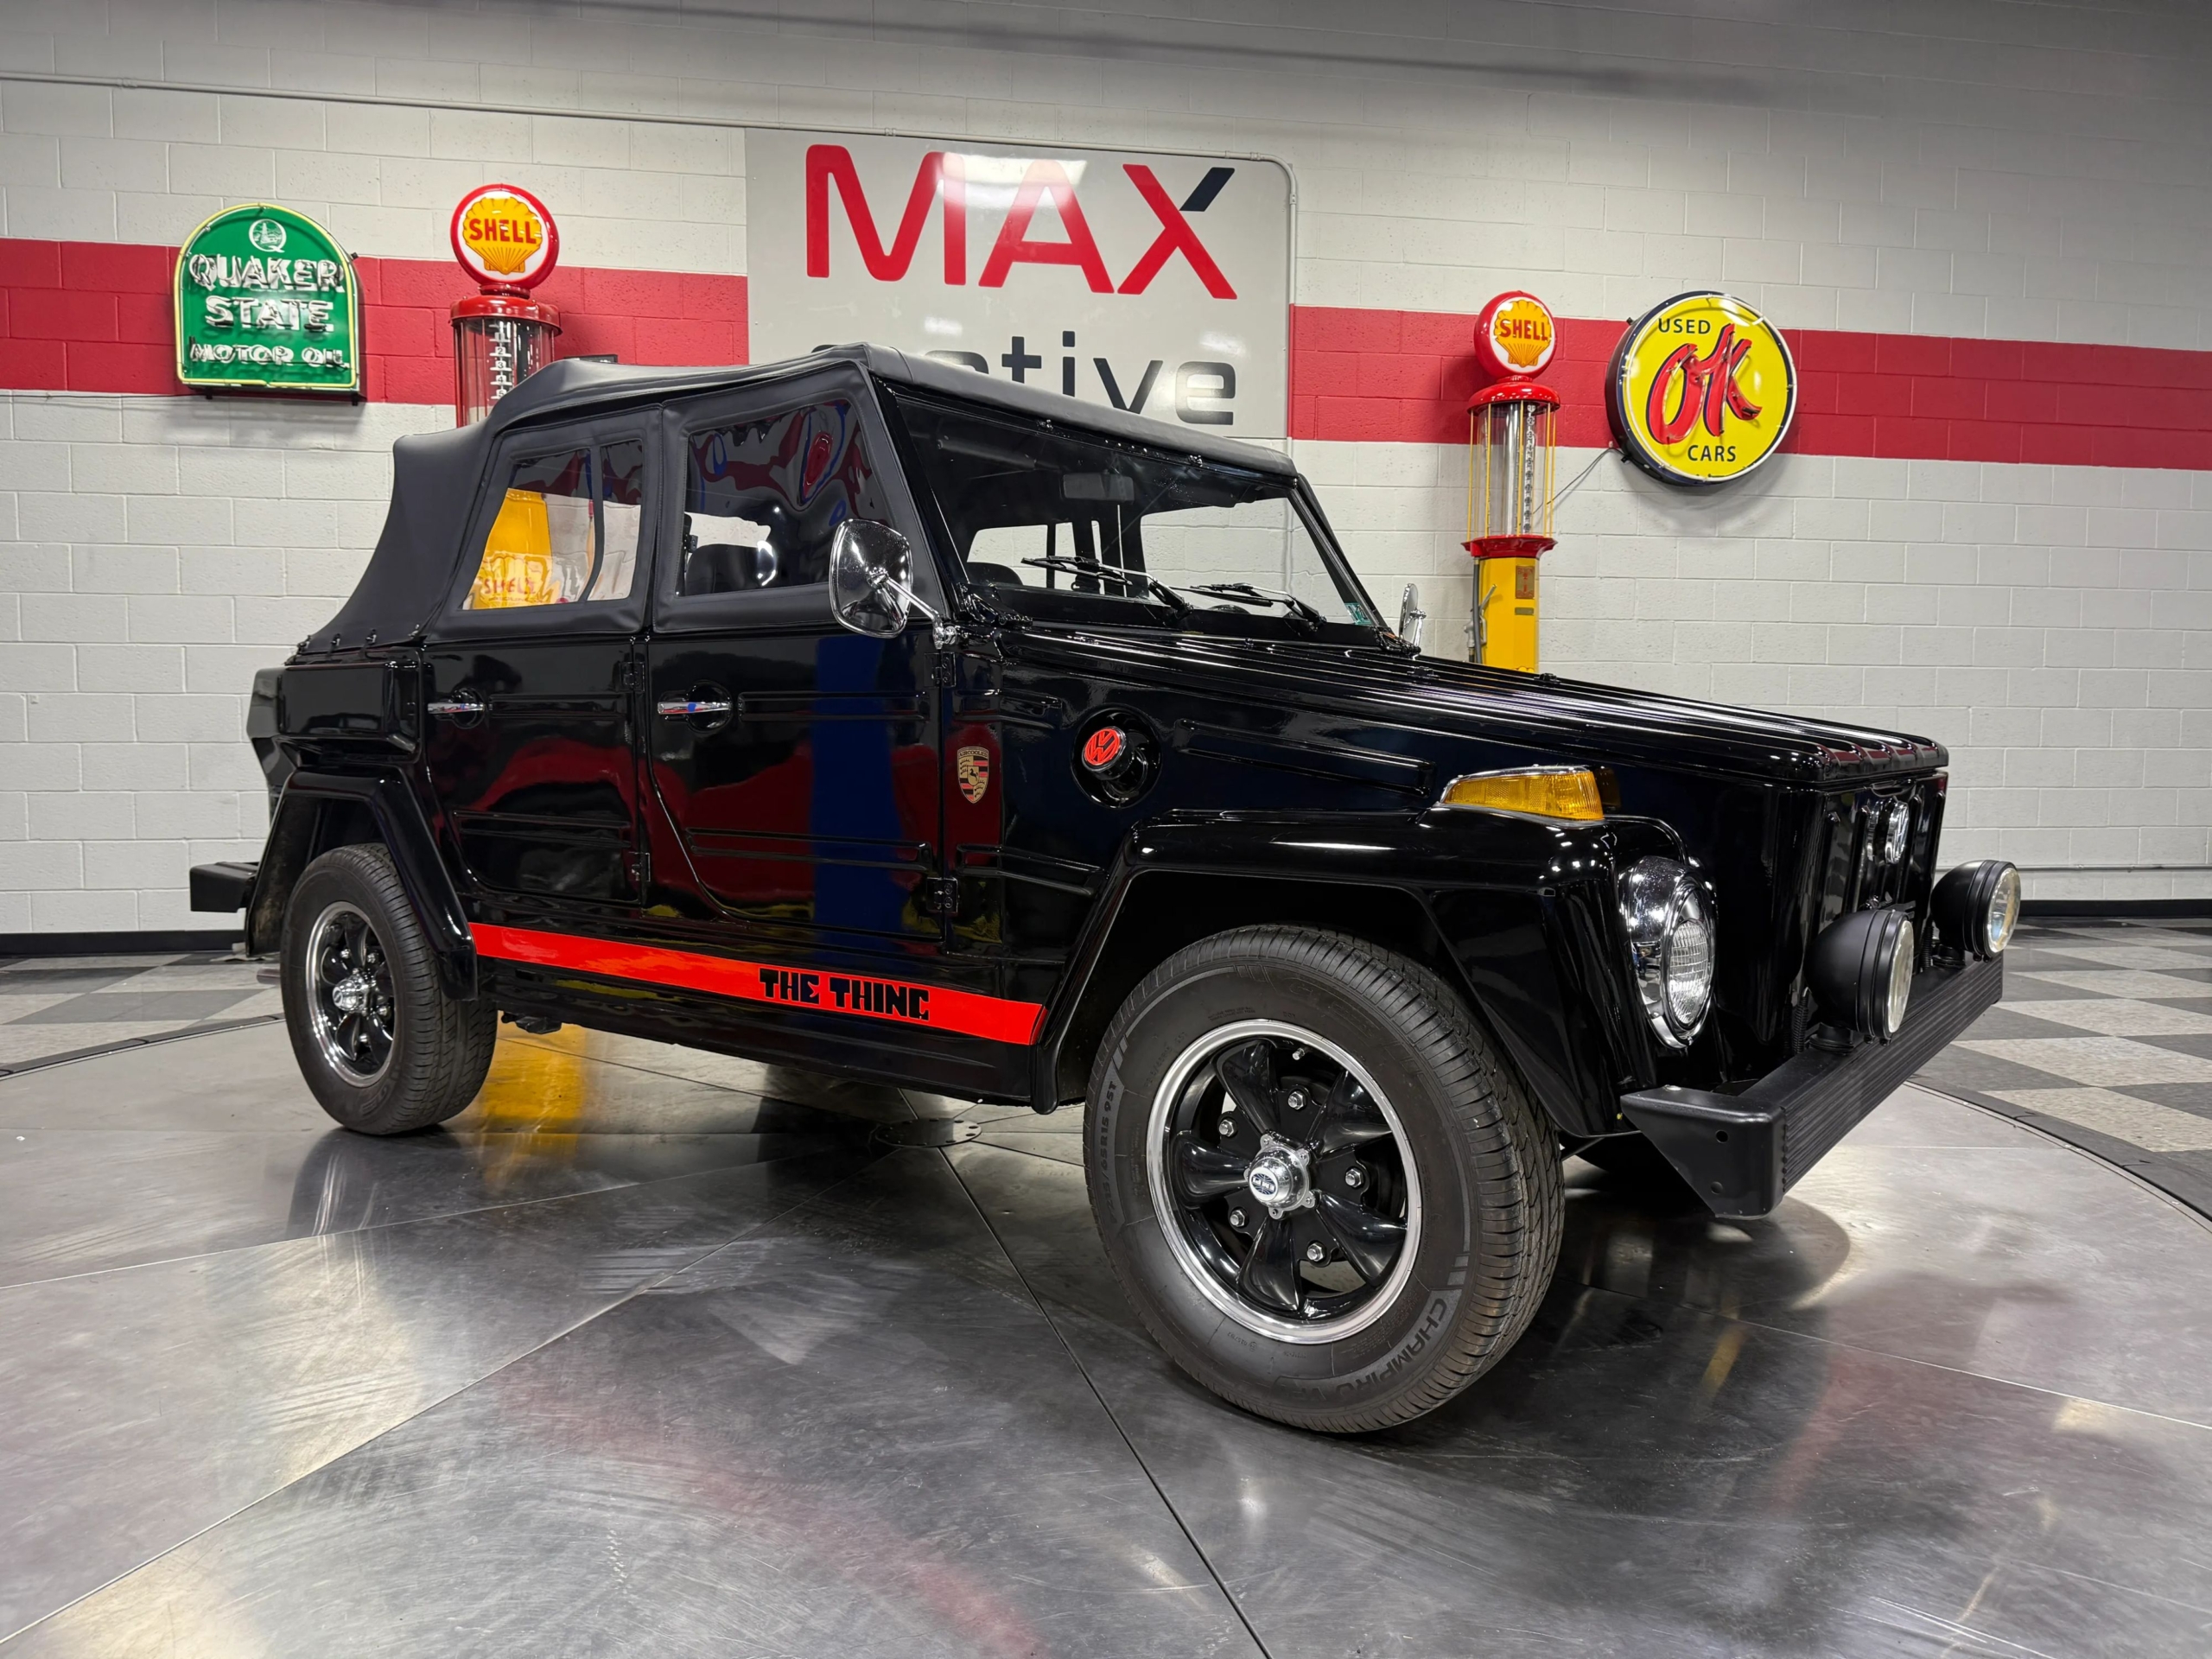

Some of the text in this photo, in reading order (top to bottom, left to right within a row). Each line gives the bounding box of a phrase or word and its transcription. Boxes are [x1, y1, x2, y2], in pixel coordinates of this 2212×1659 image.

[469, 219, 537, 244] SHELL
[805, 144, 1237, 300] MAX
[189, 254, 345, 293] QUAKER
[205, 296, 334, 332] STATE
[1499, 318, 1548, 341] SHELL
[1658, 318, 1711, 334] USED
[190, 344, 349, 369] MOTOR OIL
[1646, 323, 1763, 444] OK
[1688, 445, 1736, 461] CARS
[760, 967, 930, 1021] THE THING
[1104, 1080, 1117, 1113] 95T
[1336, 1298, 1448, 1394] CHAMPIRO
